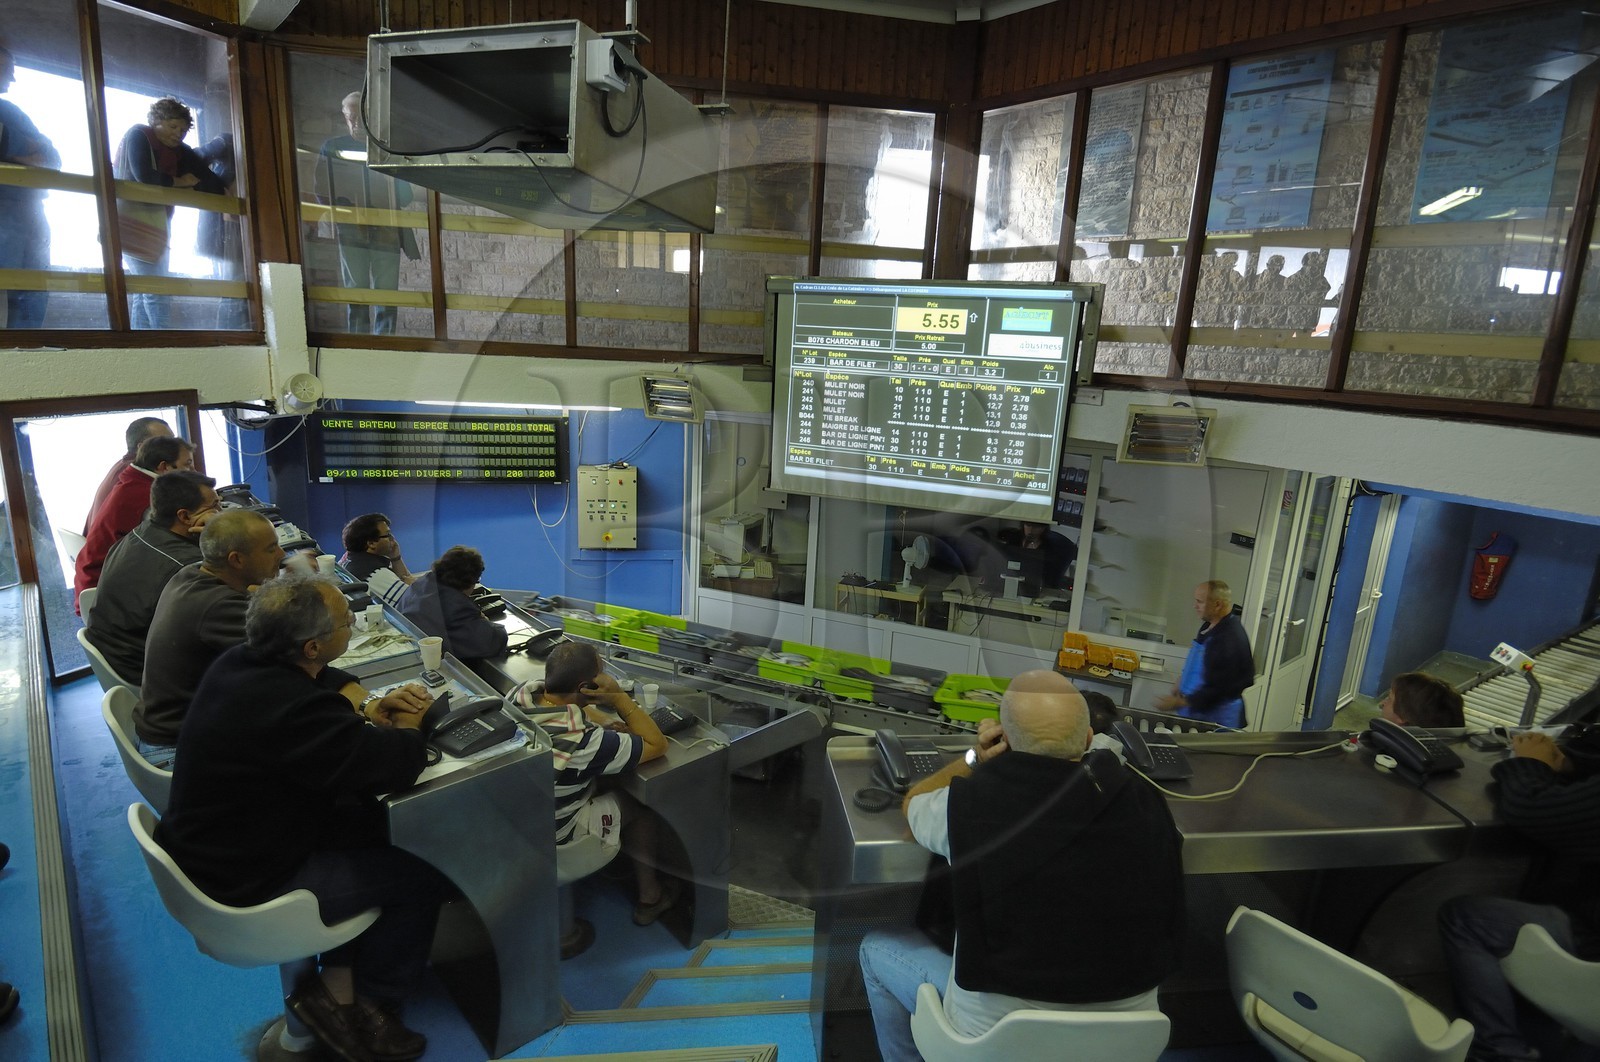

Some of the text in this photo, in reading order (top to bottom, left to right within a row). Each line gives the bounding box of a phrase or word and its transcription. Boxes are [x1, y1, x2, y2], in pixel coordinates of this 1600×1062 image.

[922, 313, 960, 328] 5.55
[826, 338, 859, 346] CHARDON
[825, 381, 848, 389] MULET
[322, 420, 554, 432] VENTE BATEAU ESPECE BAC POIDS TOTAL
[822, 422, 848, 430] MAIGRE
[848, 433, 868, 441] LIGNE
[950, 464, 970, 472] Poids
[326, 469, 555, 478] 09/10 ABSIDE-M DIVERS P 0 200 200
[1028, 482, 1046, 490] A018
